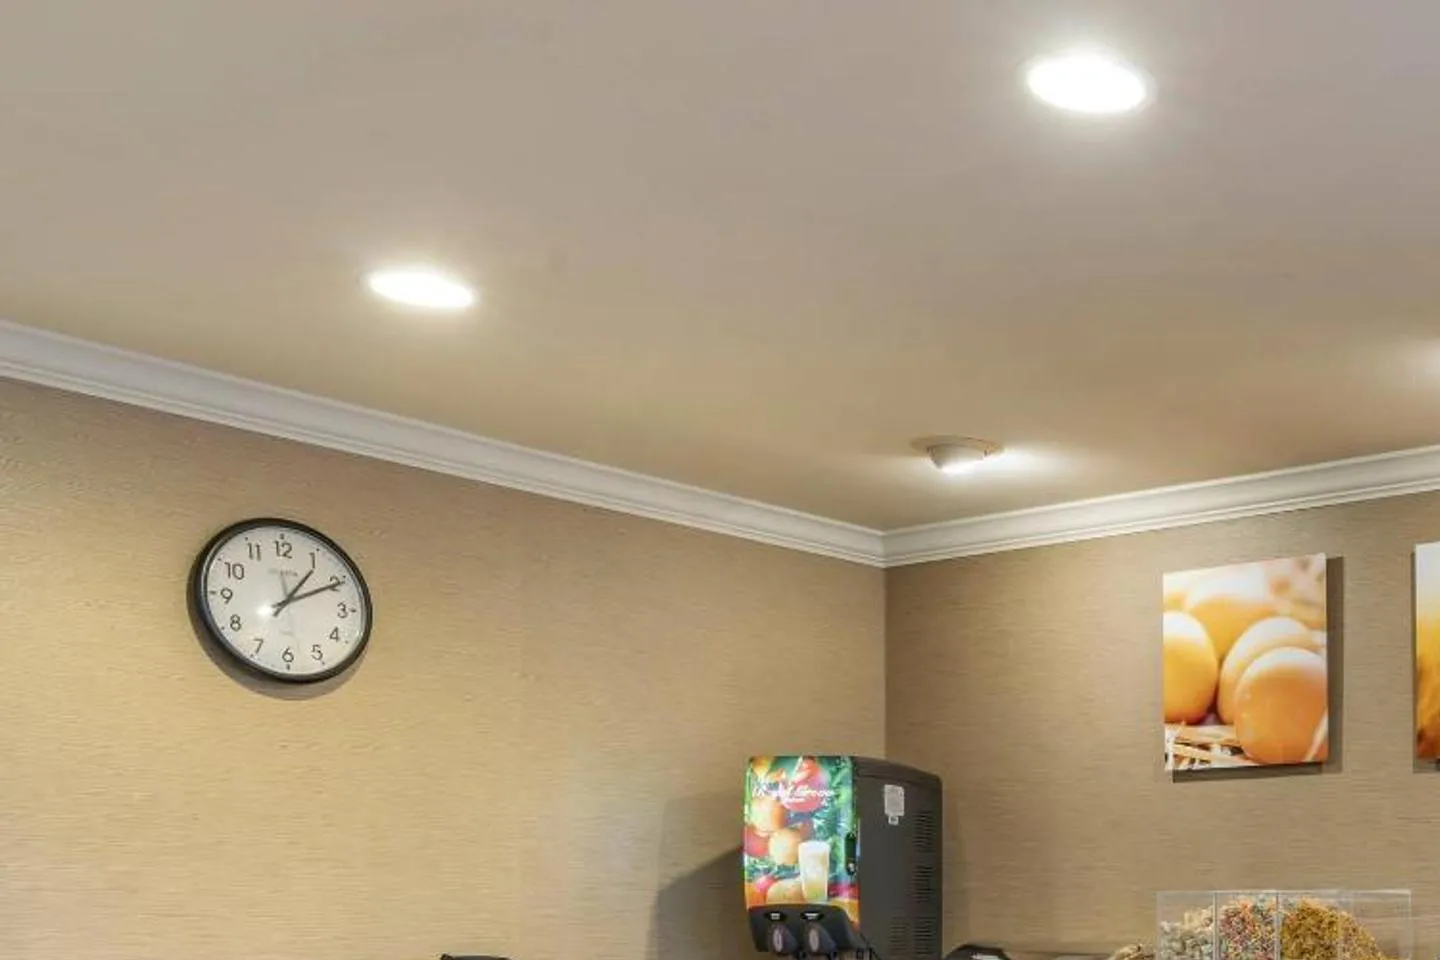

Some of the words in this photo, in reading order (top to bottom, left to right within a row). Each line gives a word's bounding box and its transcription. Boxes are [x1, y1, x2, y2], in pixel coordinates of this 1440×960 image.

[247, 542, 262, 562] 11
[274, 540, 293, 560] 12
[308, 551, 316, 570] 1
[224, 561, 245, 581] 10
[220, 587, 233, 605] 9
[337, 602, 349, 619] 3
[229, 614, 242, 632] 8
[329, 626, 340, 643] 4
[252, 638, 264, 655] 7
[281, 647, 295, 663] 6
[312, 644, 324, 661] 5
